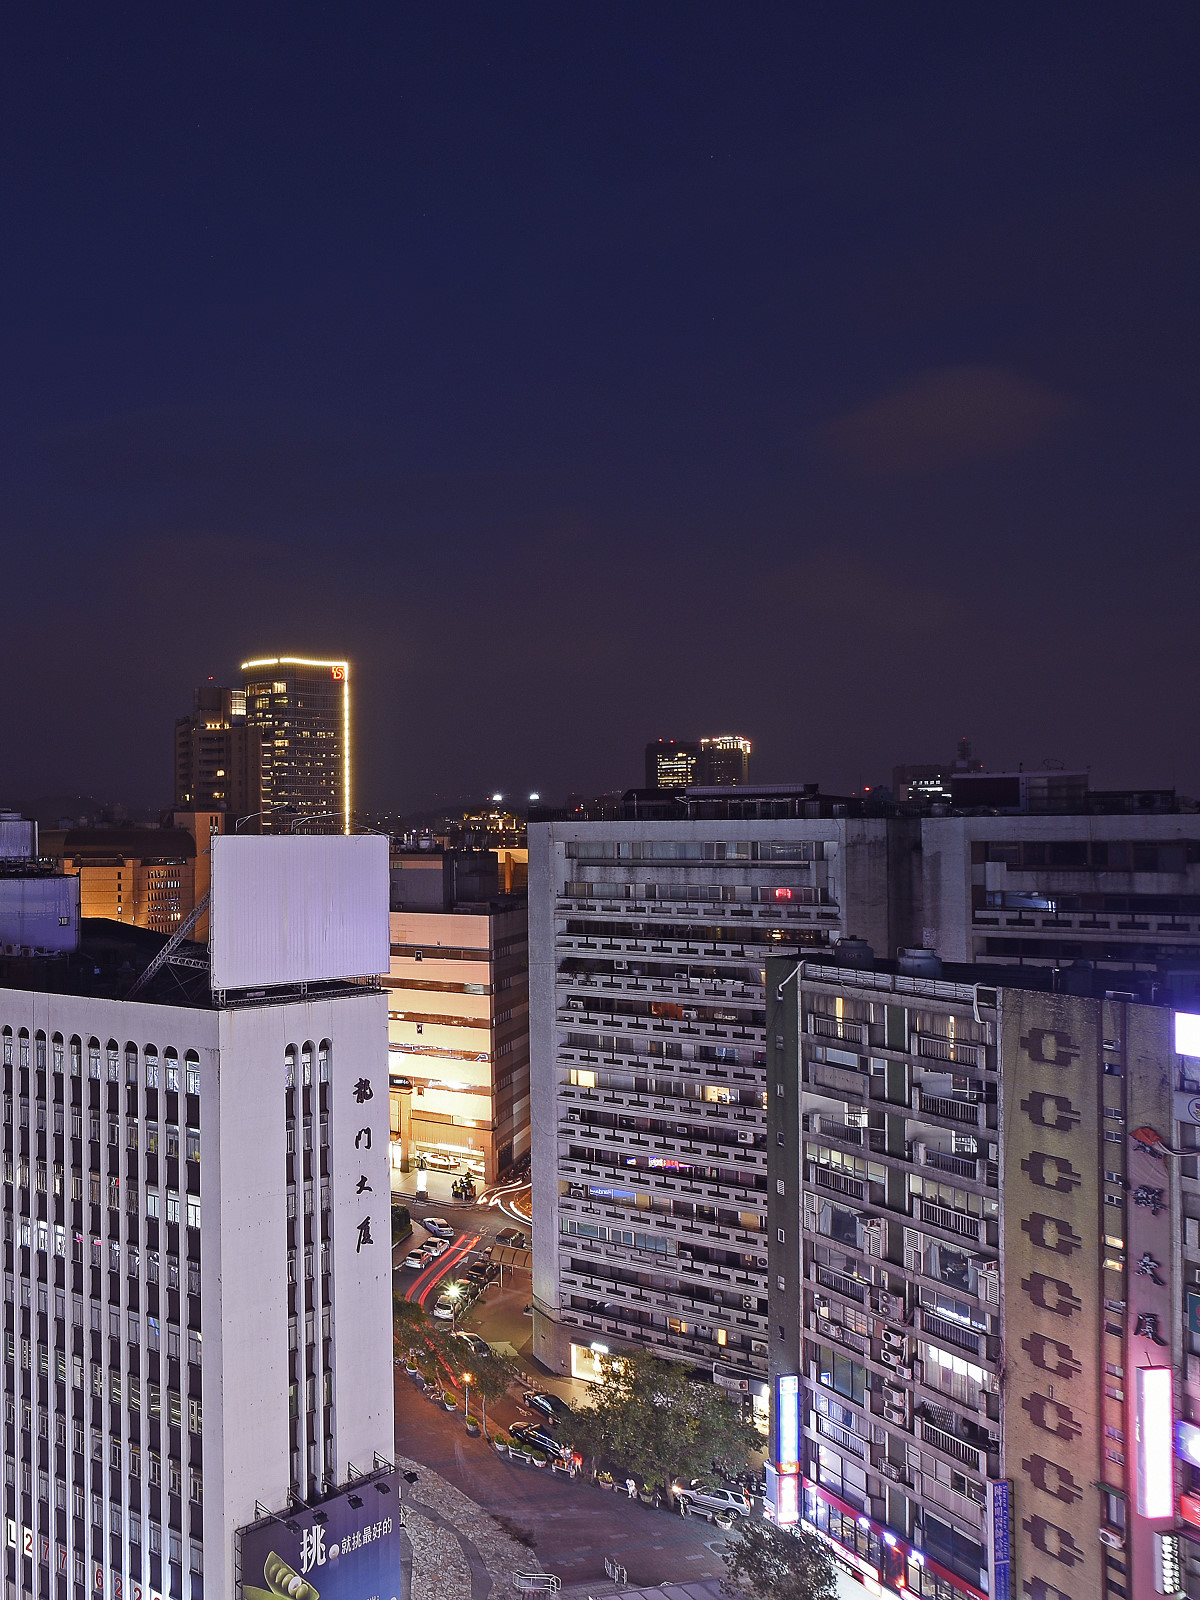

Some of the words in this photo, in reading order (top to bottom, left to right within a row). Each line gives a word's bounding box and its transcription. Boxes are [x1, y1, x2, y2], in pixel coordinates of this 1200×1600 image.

[299, 1523, 327, 1575] 挑
[340, 1516, 393, 1555] 就挑最好的
